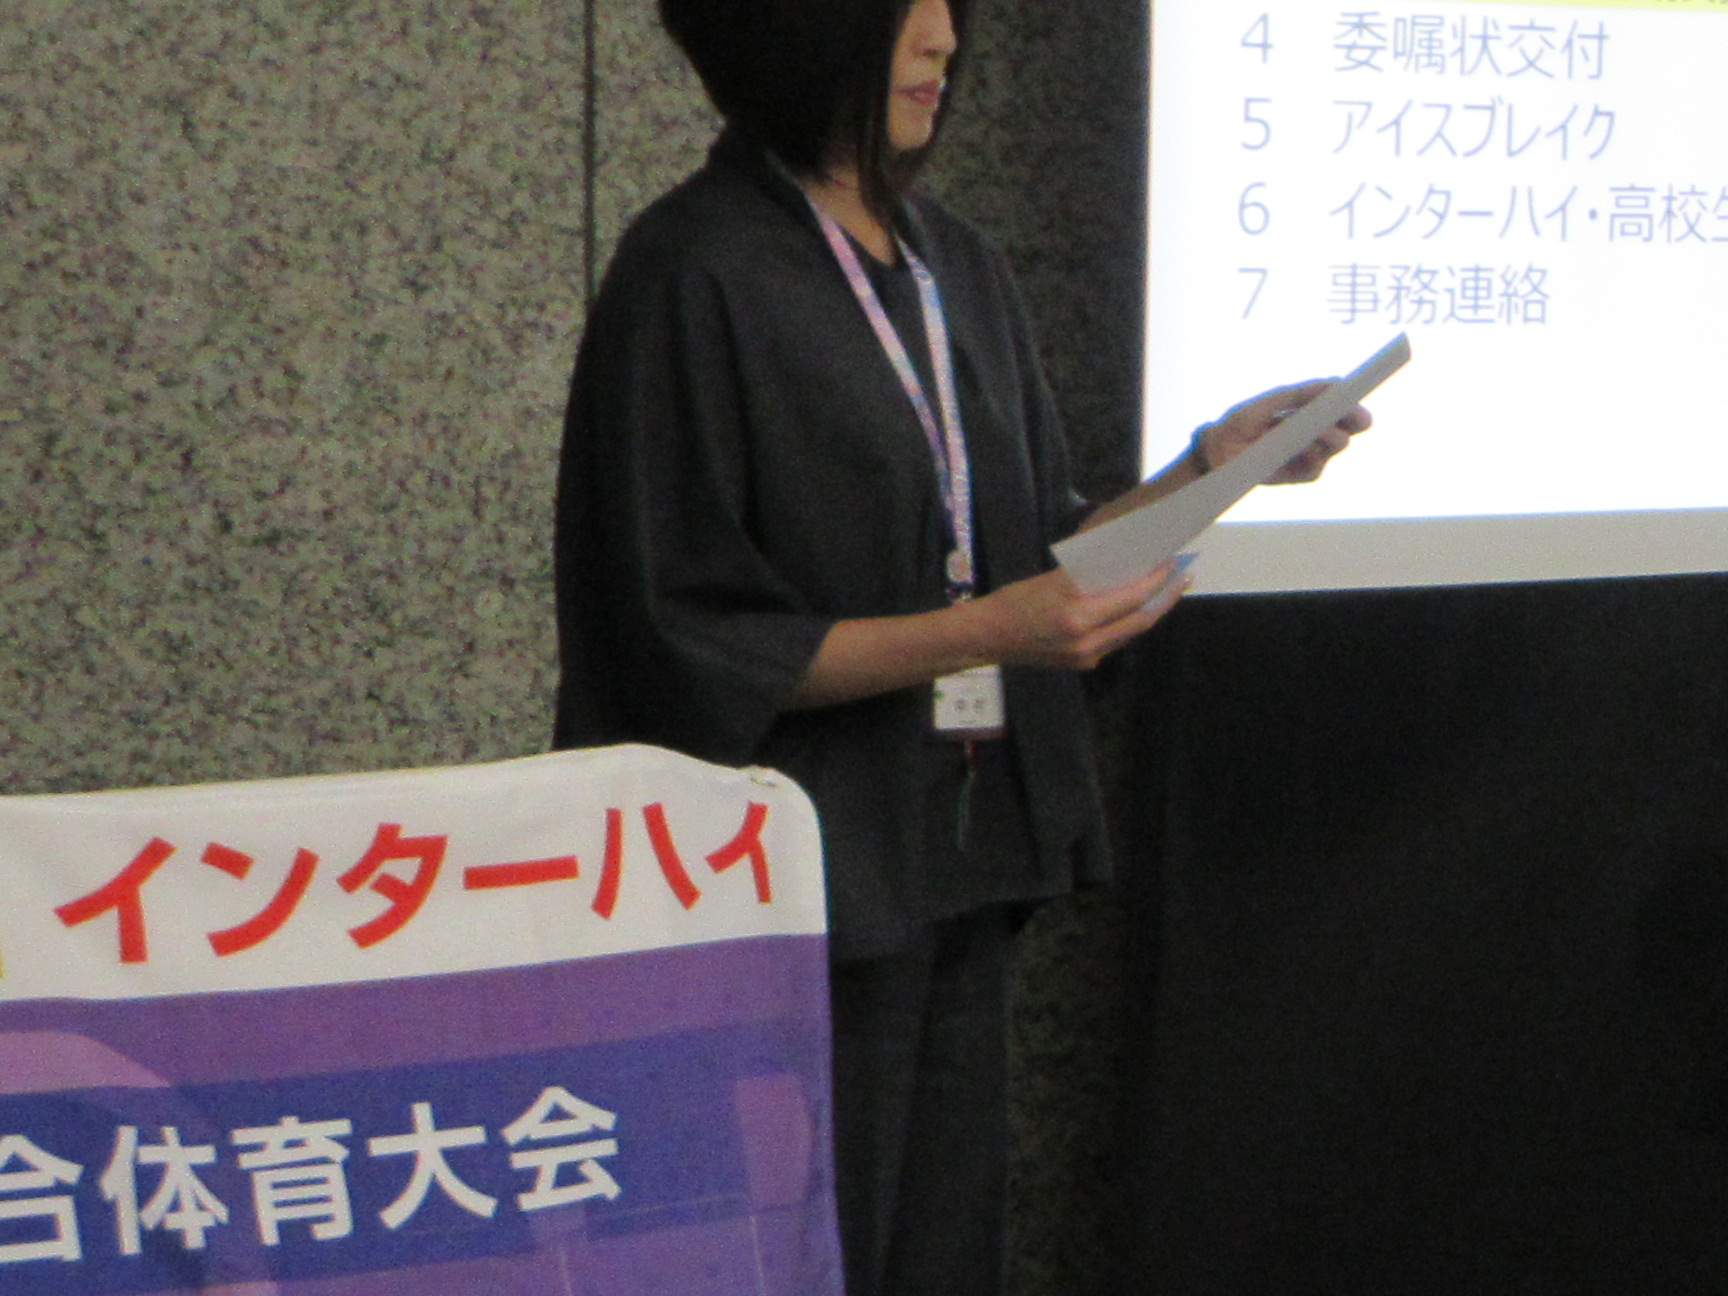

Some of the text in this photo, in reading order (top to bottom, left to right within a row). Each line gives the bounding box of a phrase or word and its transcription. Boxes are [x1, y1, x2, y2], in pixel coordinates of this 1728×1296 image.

[1240, 10, 1610, 81] 4 委嘱状交付
[1240, 95, 1617, 161] 5 アイスブレイク
[1237, 181, 1270, 236] 6
[1237, 262, 1551, 326] 7 事務連絡
[52, 799, 775, 965] インターハイ
[0, 1086, 622, 1266] 合体育大会
